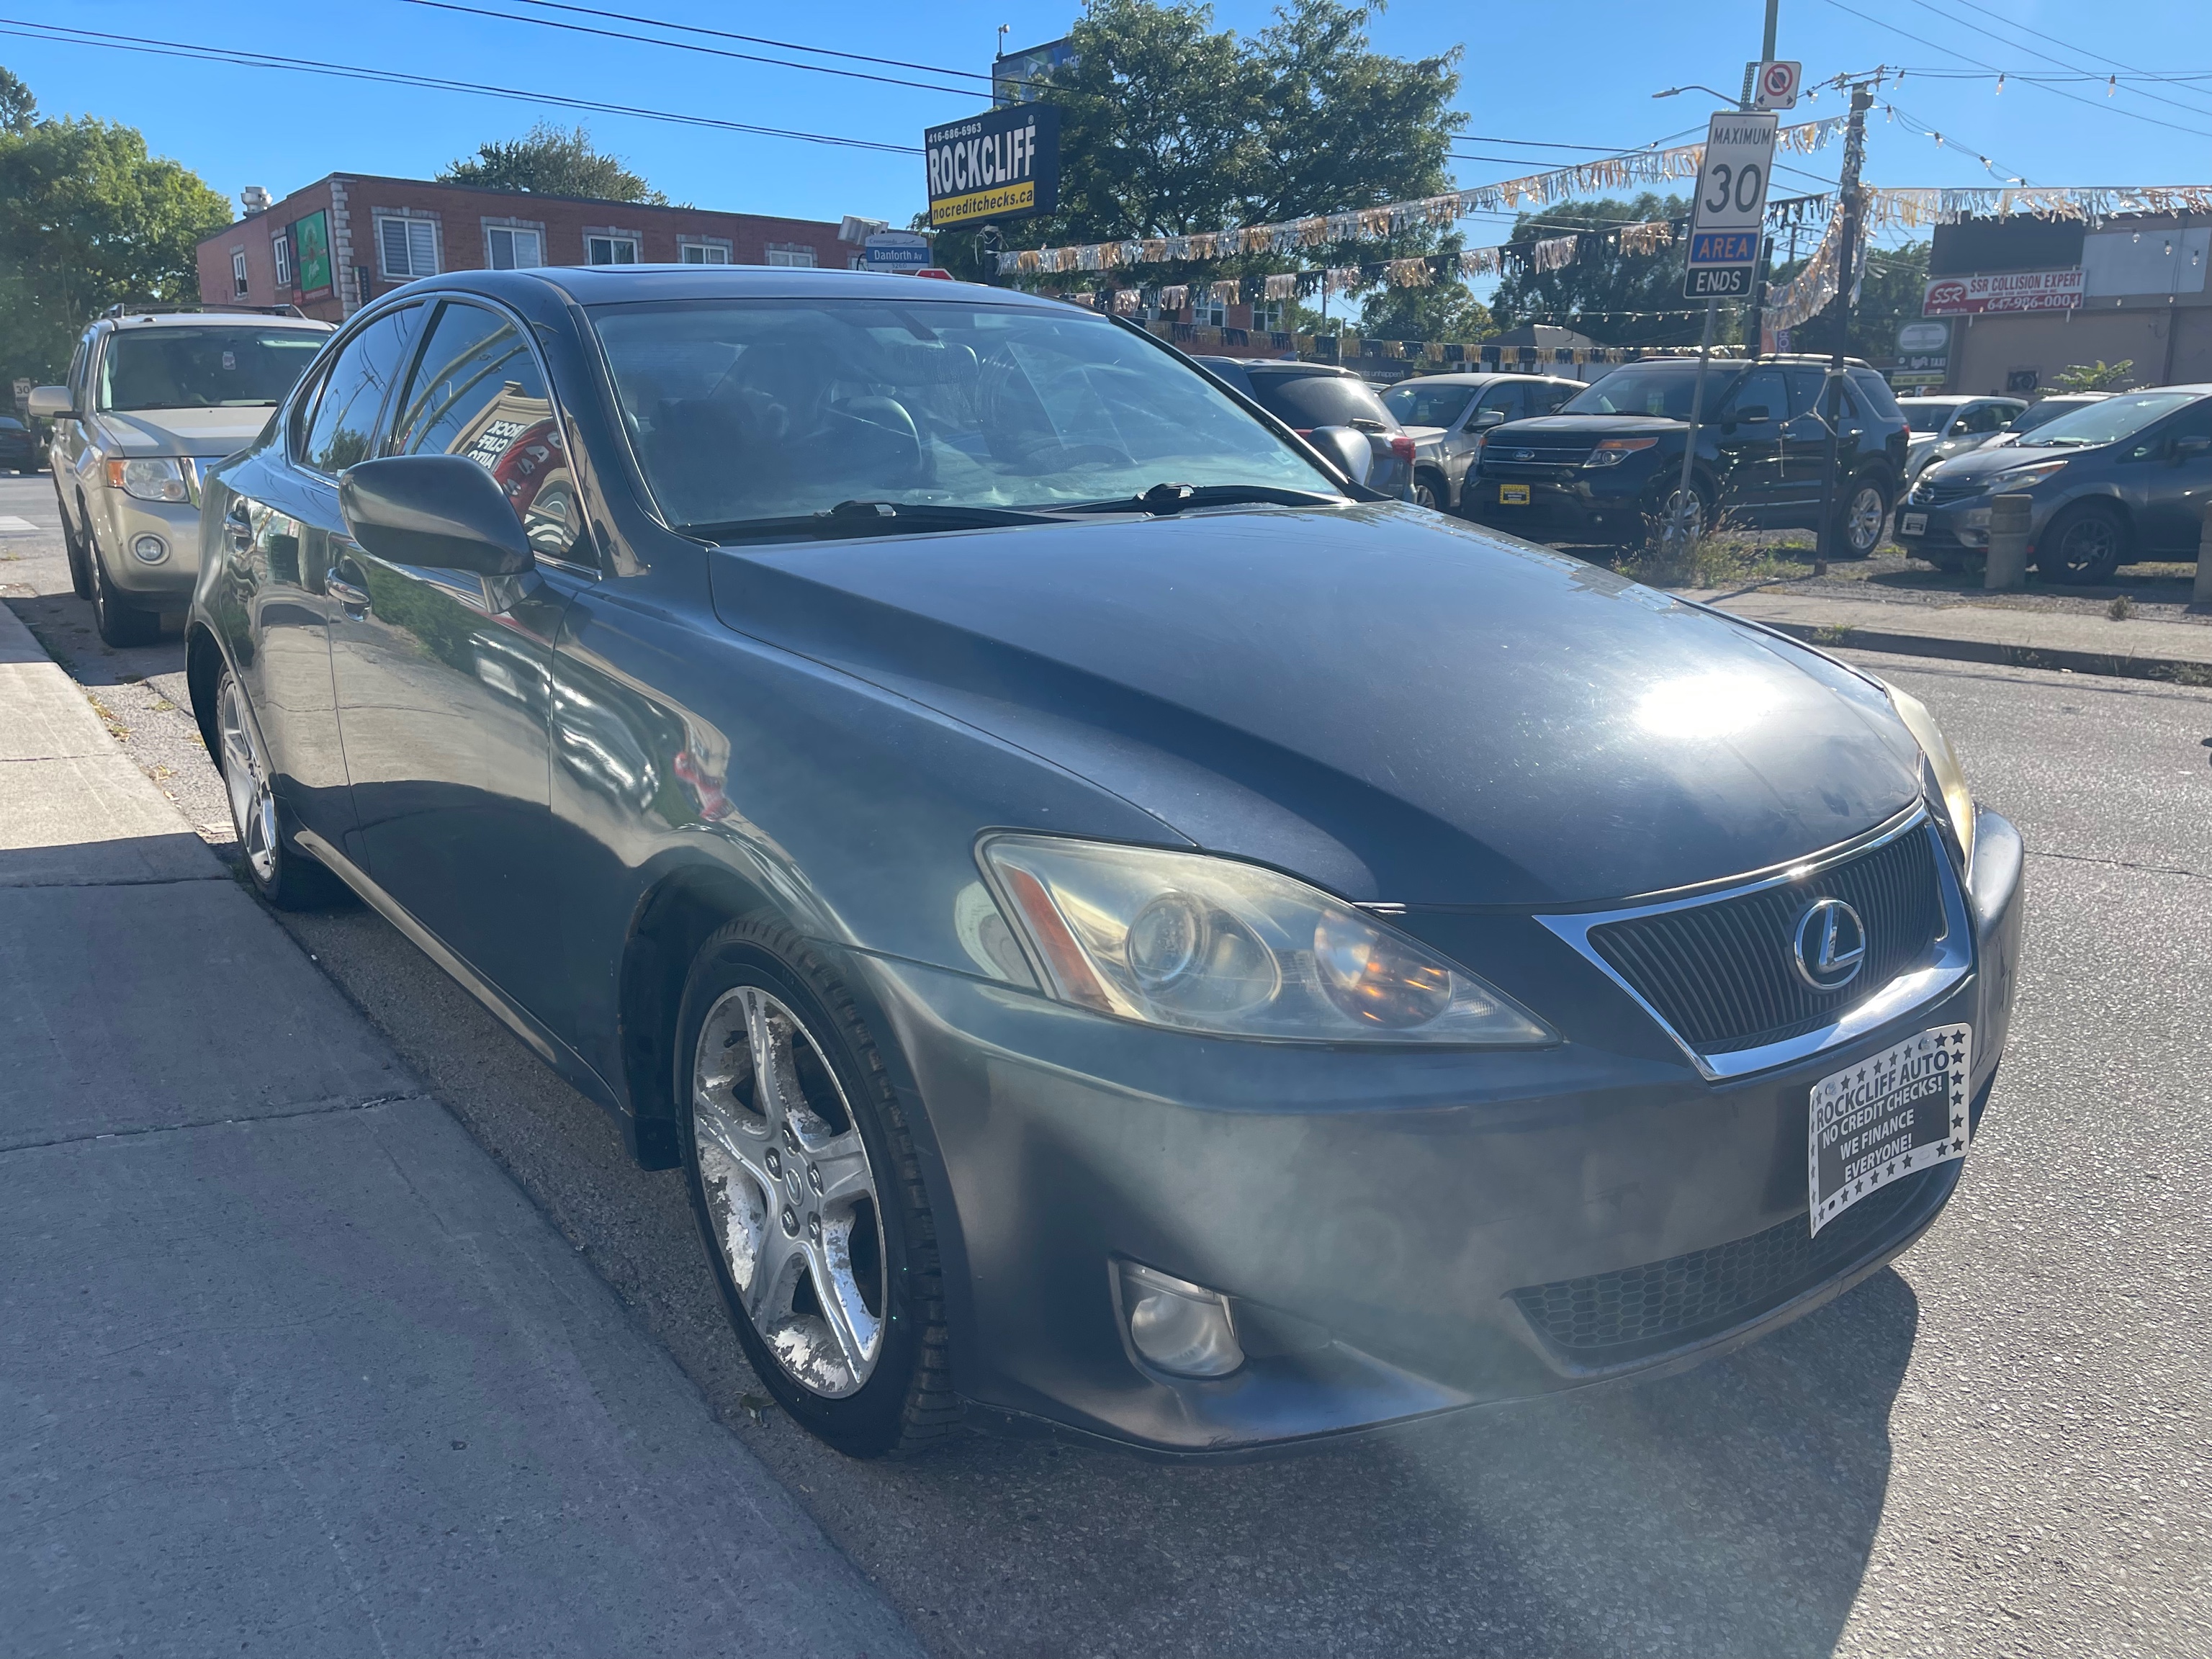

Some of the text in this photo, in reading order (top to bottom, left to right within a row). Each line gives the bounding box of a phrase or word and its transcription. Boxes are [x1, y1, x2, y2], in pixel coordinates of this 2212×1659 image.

[928, 122, 982, 143] 416-686-6963
[1714, 127, 1772, 145] MAXIMUM
[929, 125, 1035, 196] ROCKCLIFF
[1706, 163, 1762, 213] 30
[933, 189, 1033, 220] nocreditchecks.ca
[874, 249, 912, 260] Danforth
[1698, 237, 1748, 259] AREA
[1696, 271, 1741, 292] ENDS
[1970, 273, 2082, 293] SSR COLLISION EXPERT
[1933, 287, 1964, 304] SSR
[1817, 1051, 1949, 1131] ROCKCLIFF AUTO
[1822, 1076, 1943, 1149] NO CREDIT CHECKS!
[1840, 1108, 1915, 1161] WE FINANCE
[1845, 1133, 1912, 1182] EVERYONE!
